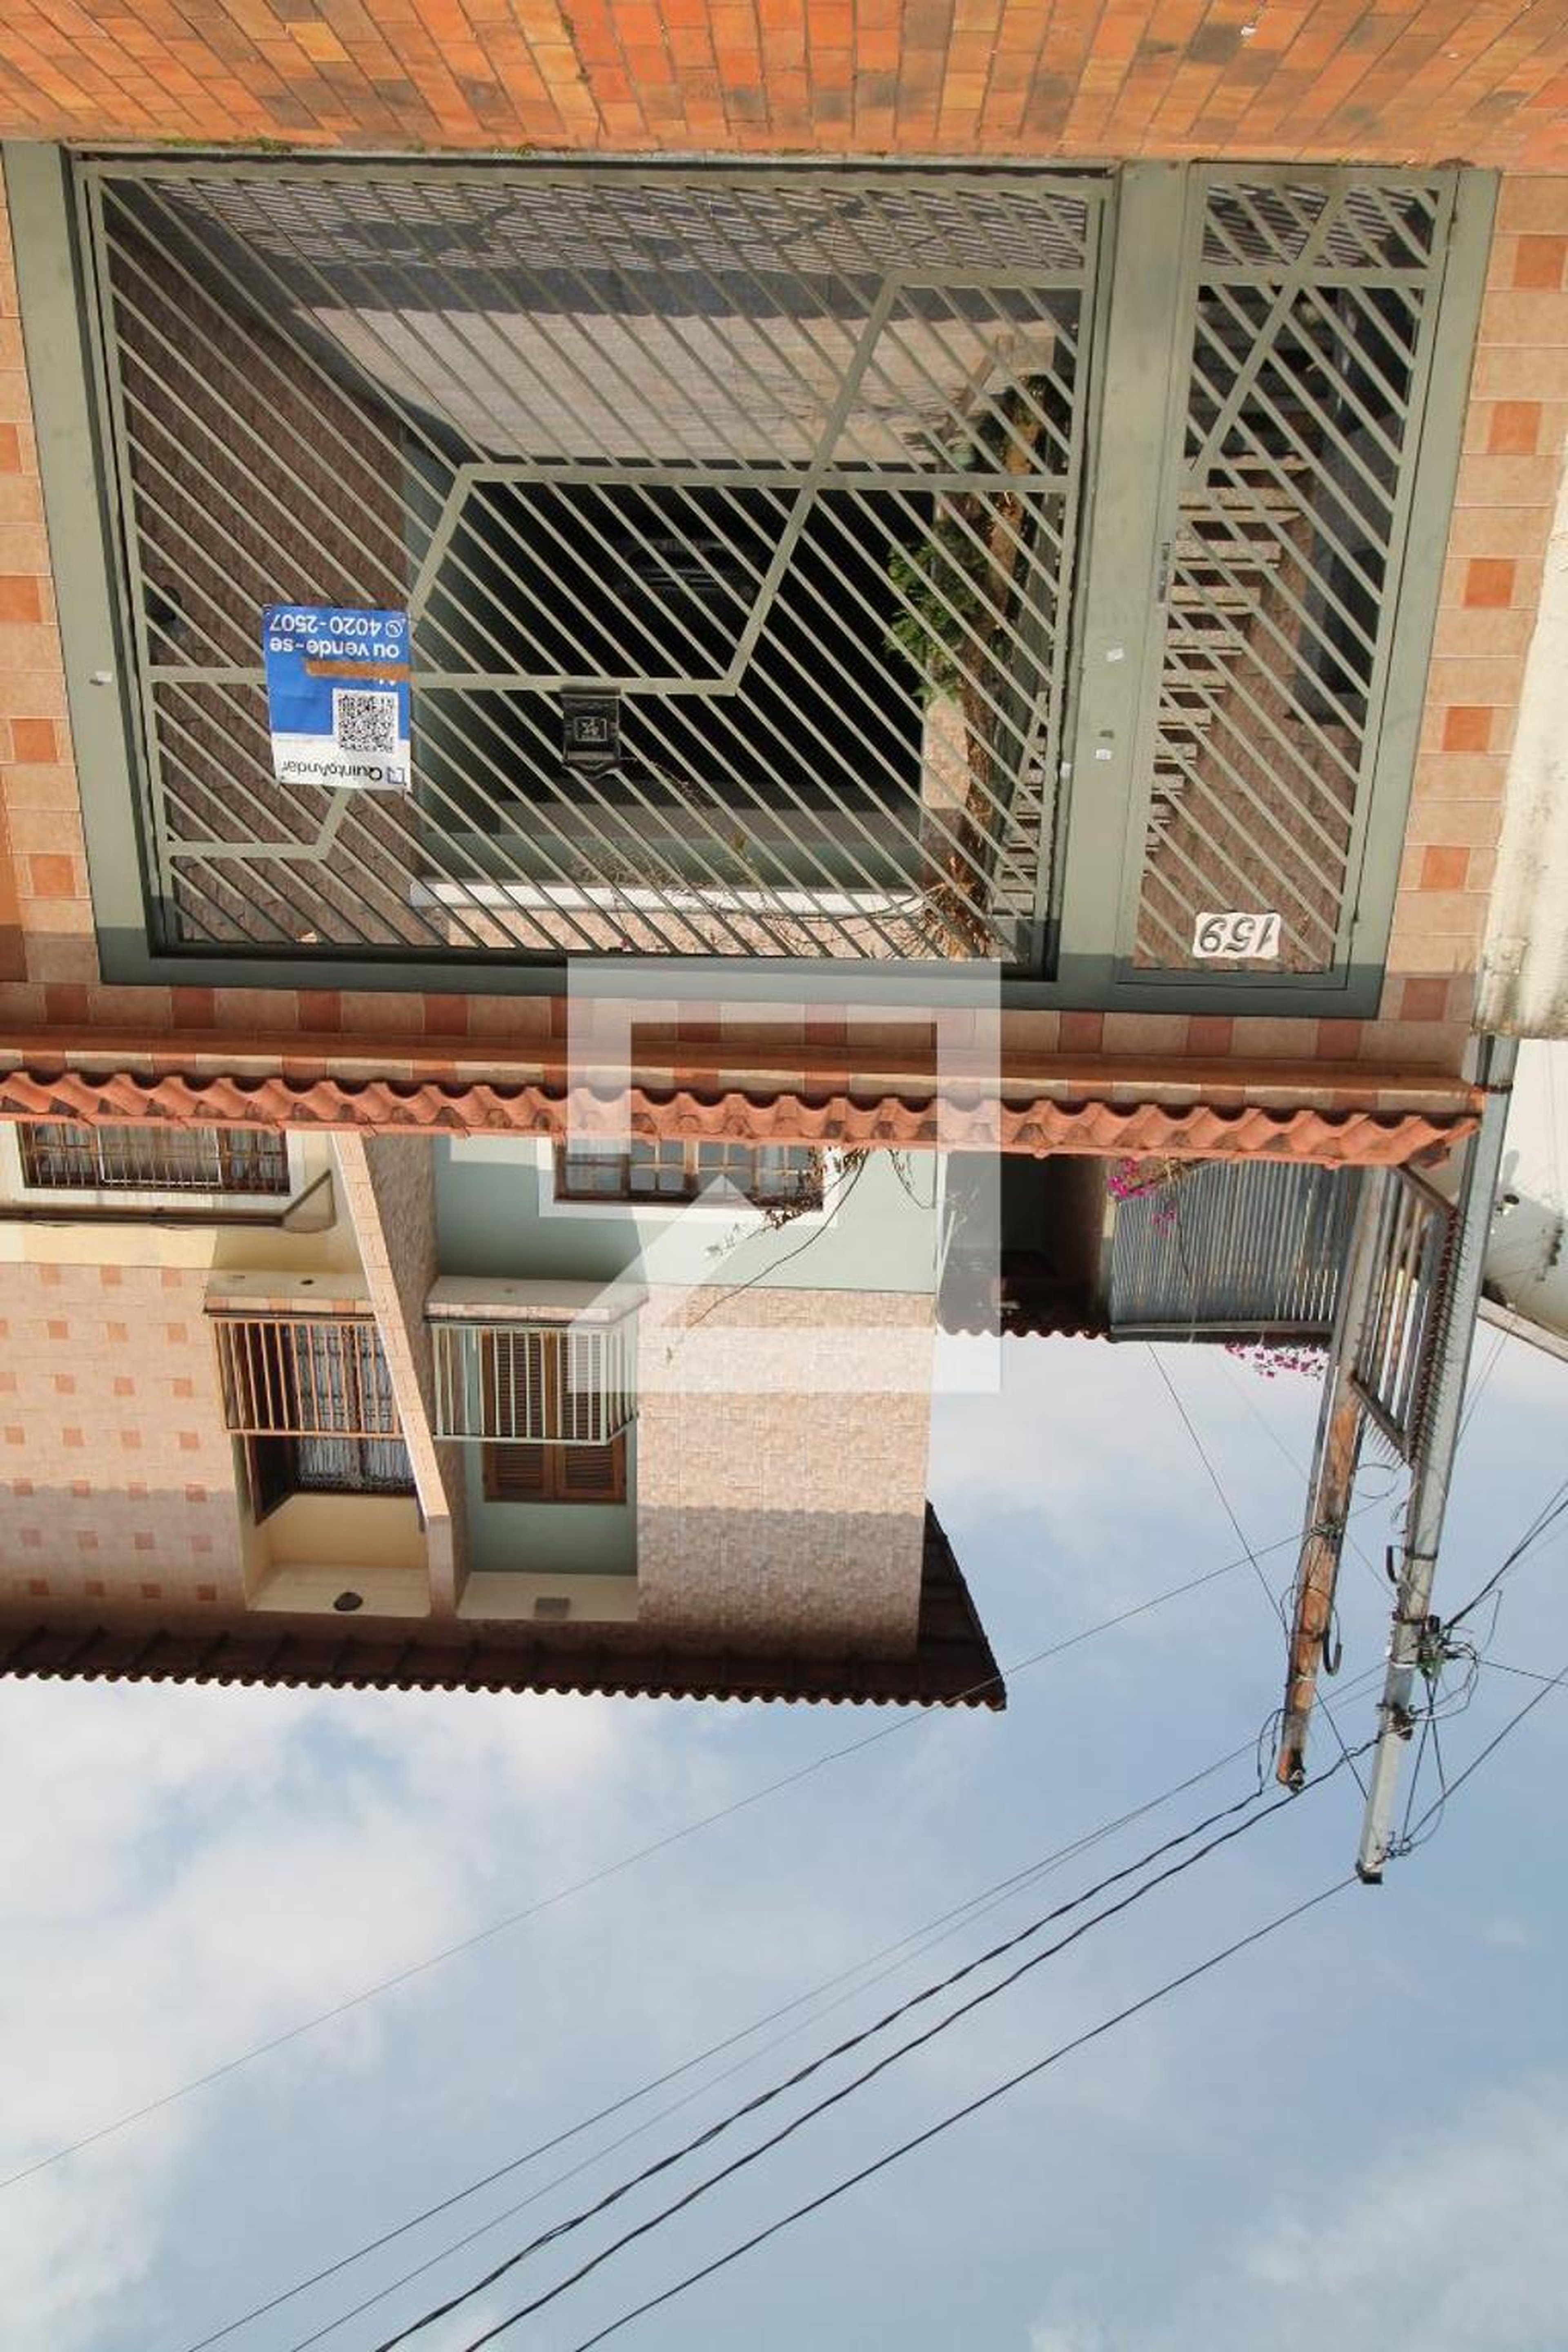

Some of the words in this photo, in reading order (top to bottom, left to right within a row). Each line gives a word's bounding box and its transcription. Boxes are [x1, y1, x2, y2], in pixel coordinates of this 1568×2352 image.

[270, 637, 369, 659] vende-se
[373, 643, 399, 658] ou
[282, 760, 383, 781] QuintoAndar
[1200, 917, 1275, 953] 159
